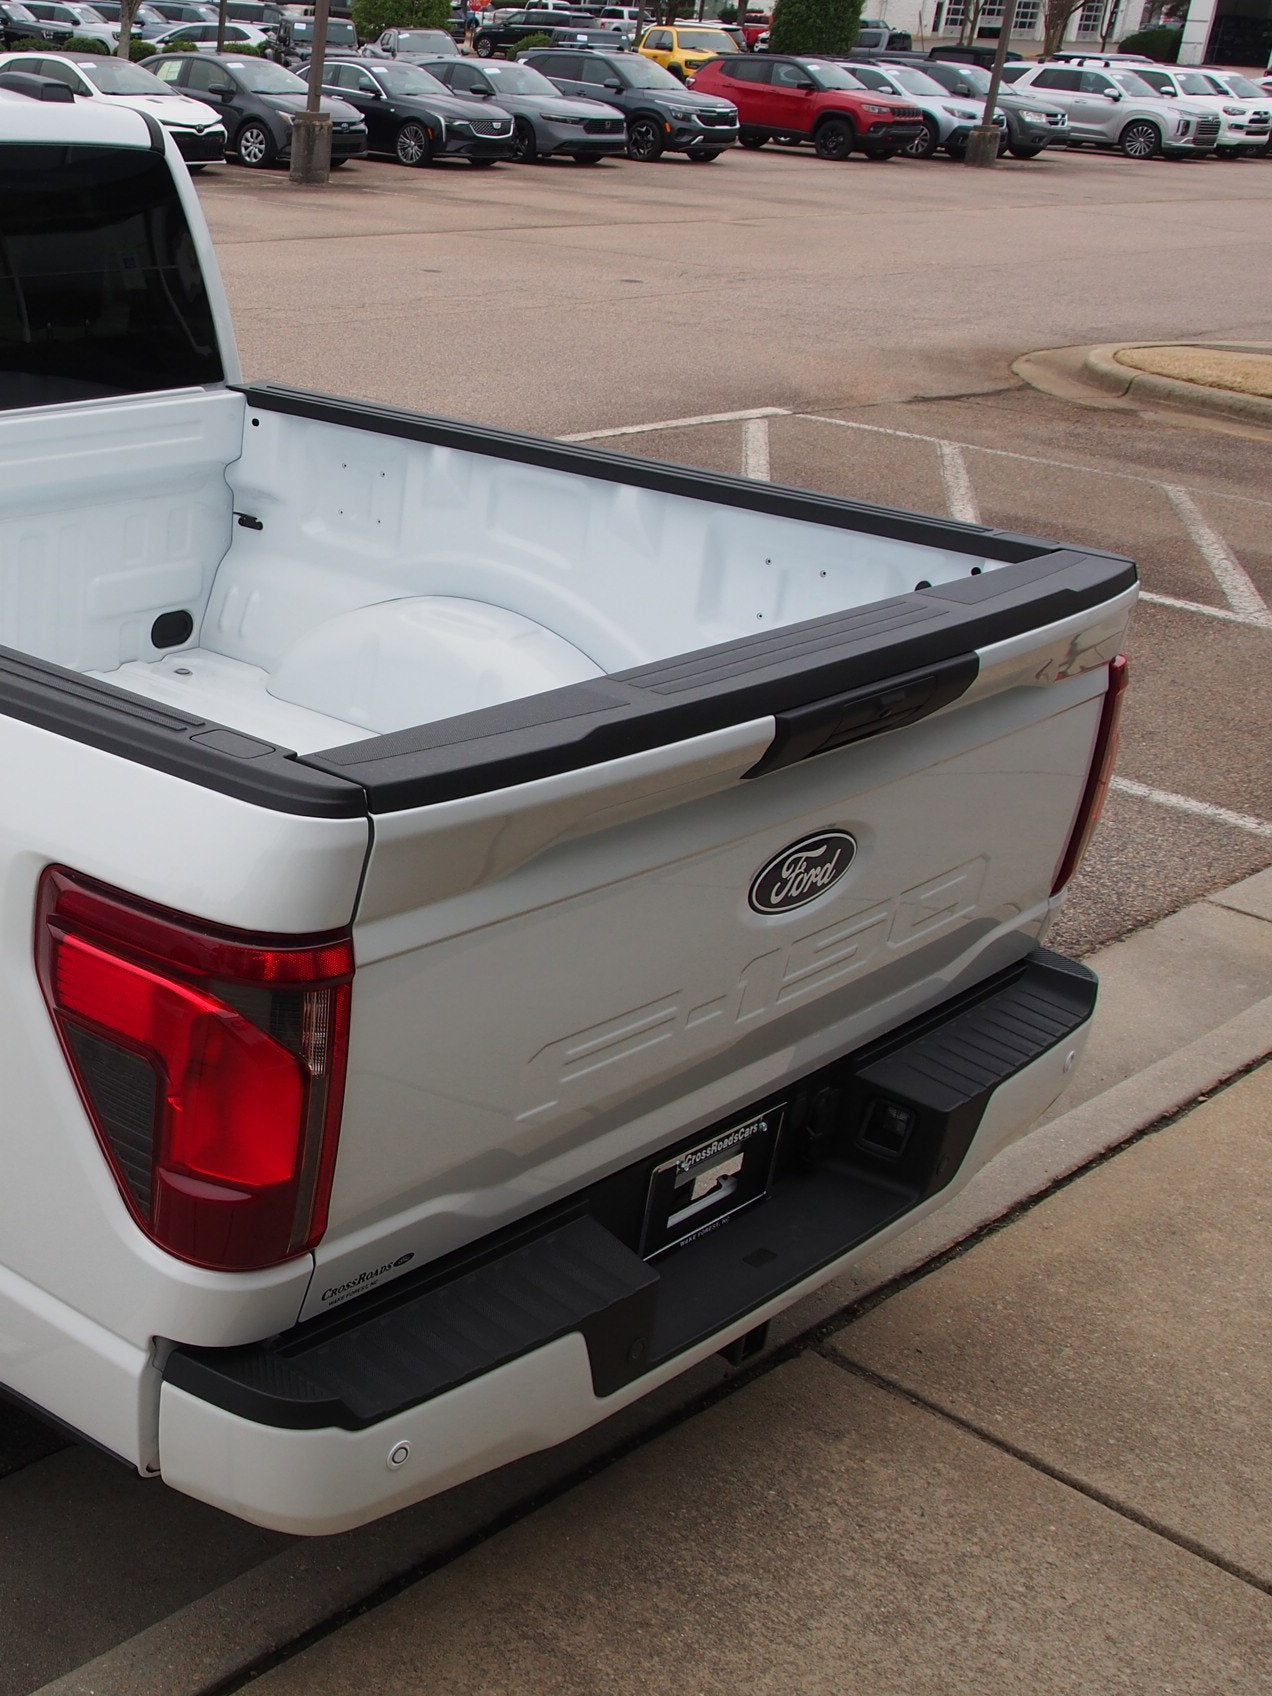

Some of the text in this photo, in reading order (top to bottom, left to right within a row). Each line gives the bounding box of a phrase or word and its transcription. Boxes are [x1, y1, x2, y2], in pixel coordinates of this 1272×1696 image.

[770, 844, 841, 905] Ford
[516, 852, 991, 1121] F-150
[683, 1122, 759, 1169] CrossRoadsCars
